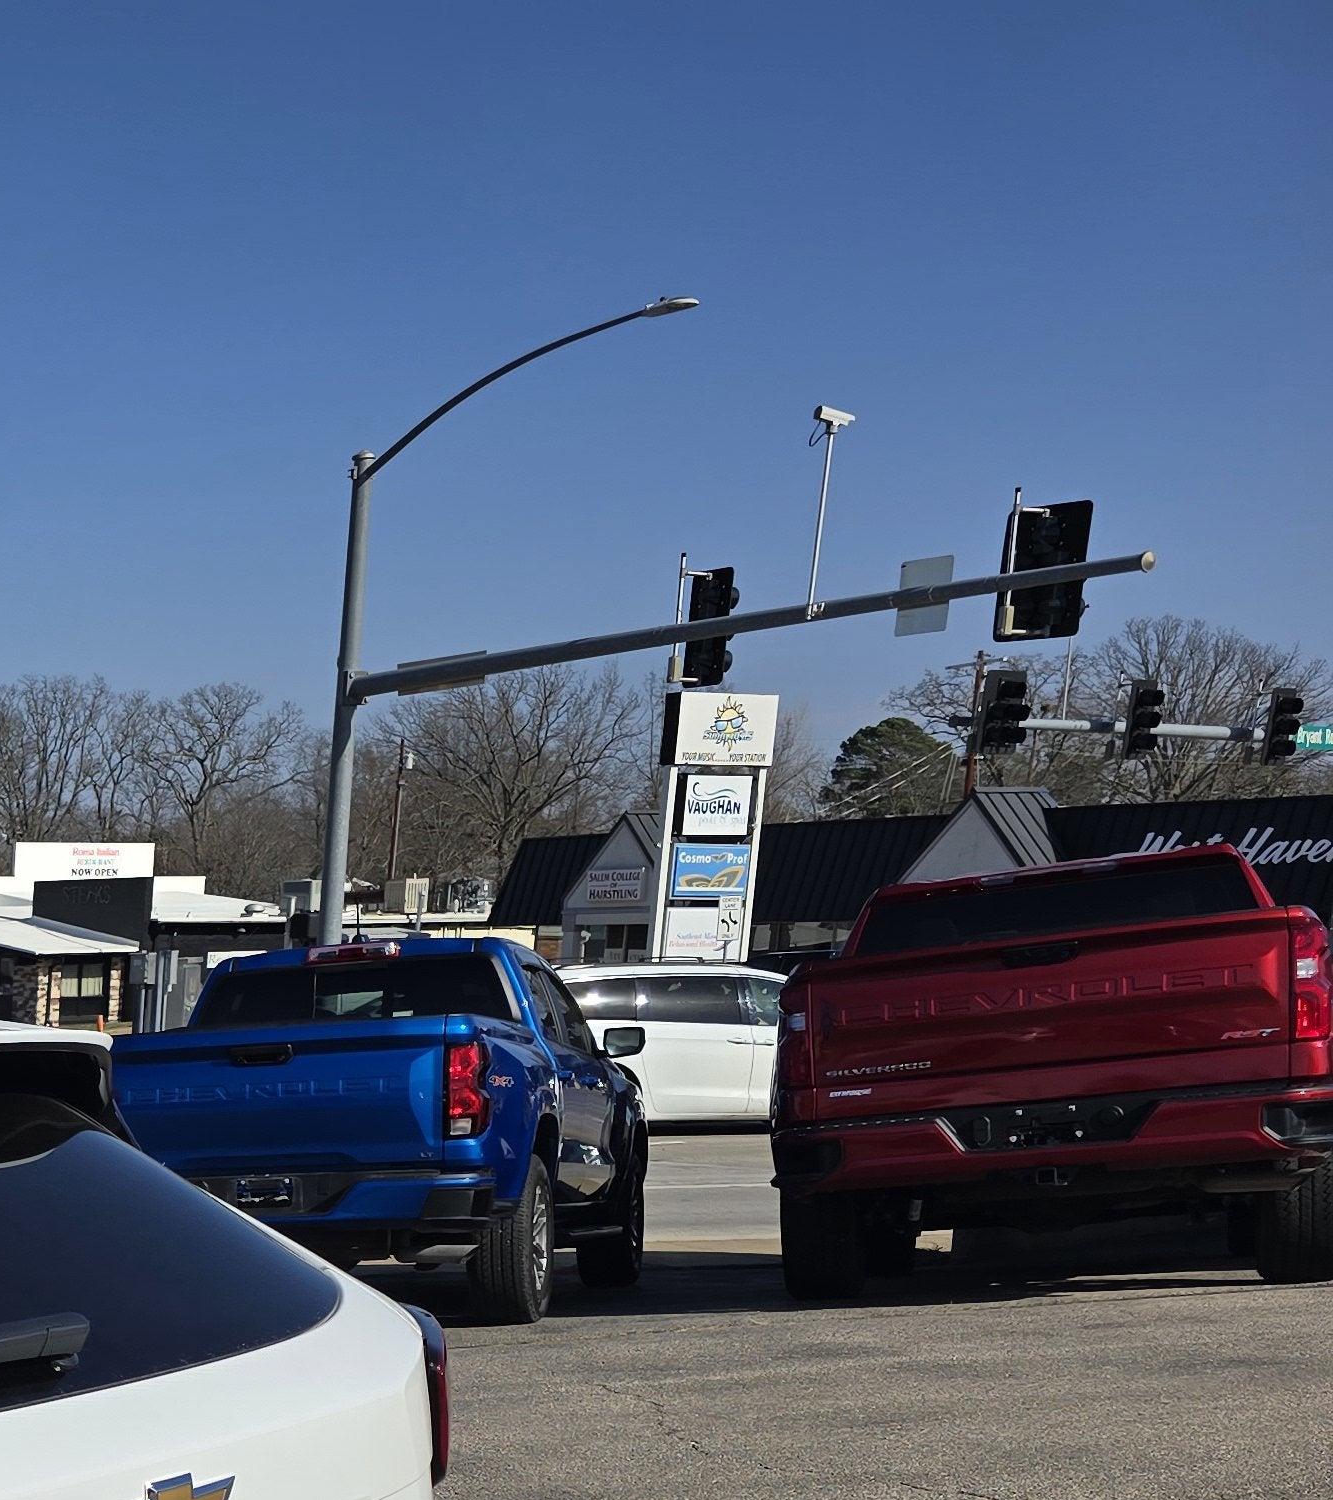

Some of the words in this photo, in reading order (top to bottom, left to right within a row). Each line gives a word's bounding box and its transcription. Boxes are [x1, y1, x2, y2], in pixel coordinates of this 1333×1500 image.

[1297, 726, 1323, 747] Bryant
[687, 799, 741, 814] VAUGHAN
[72, 847, 95, 856] Roma
[1237, 826, 1333, 865] Have
[679, 852, 712, 864] Cosmo
[727, 852, 748, 864] Prof
[71, 868, 93, 876] NOW
[94, 868, 118, 876] OPEN
[589, 872, 610, 882] SALEM
[611, 871, 640, 881] COLLEGE
[589, 889, 638, 899] HAIRSTYLING
[833, 963, 1254, 1027] CHEVROLET
[825, 1060, 932, 1079] SILVERADO
